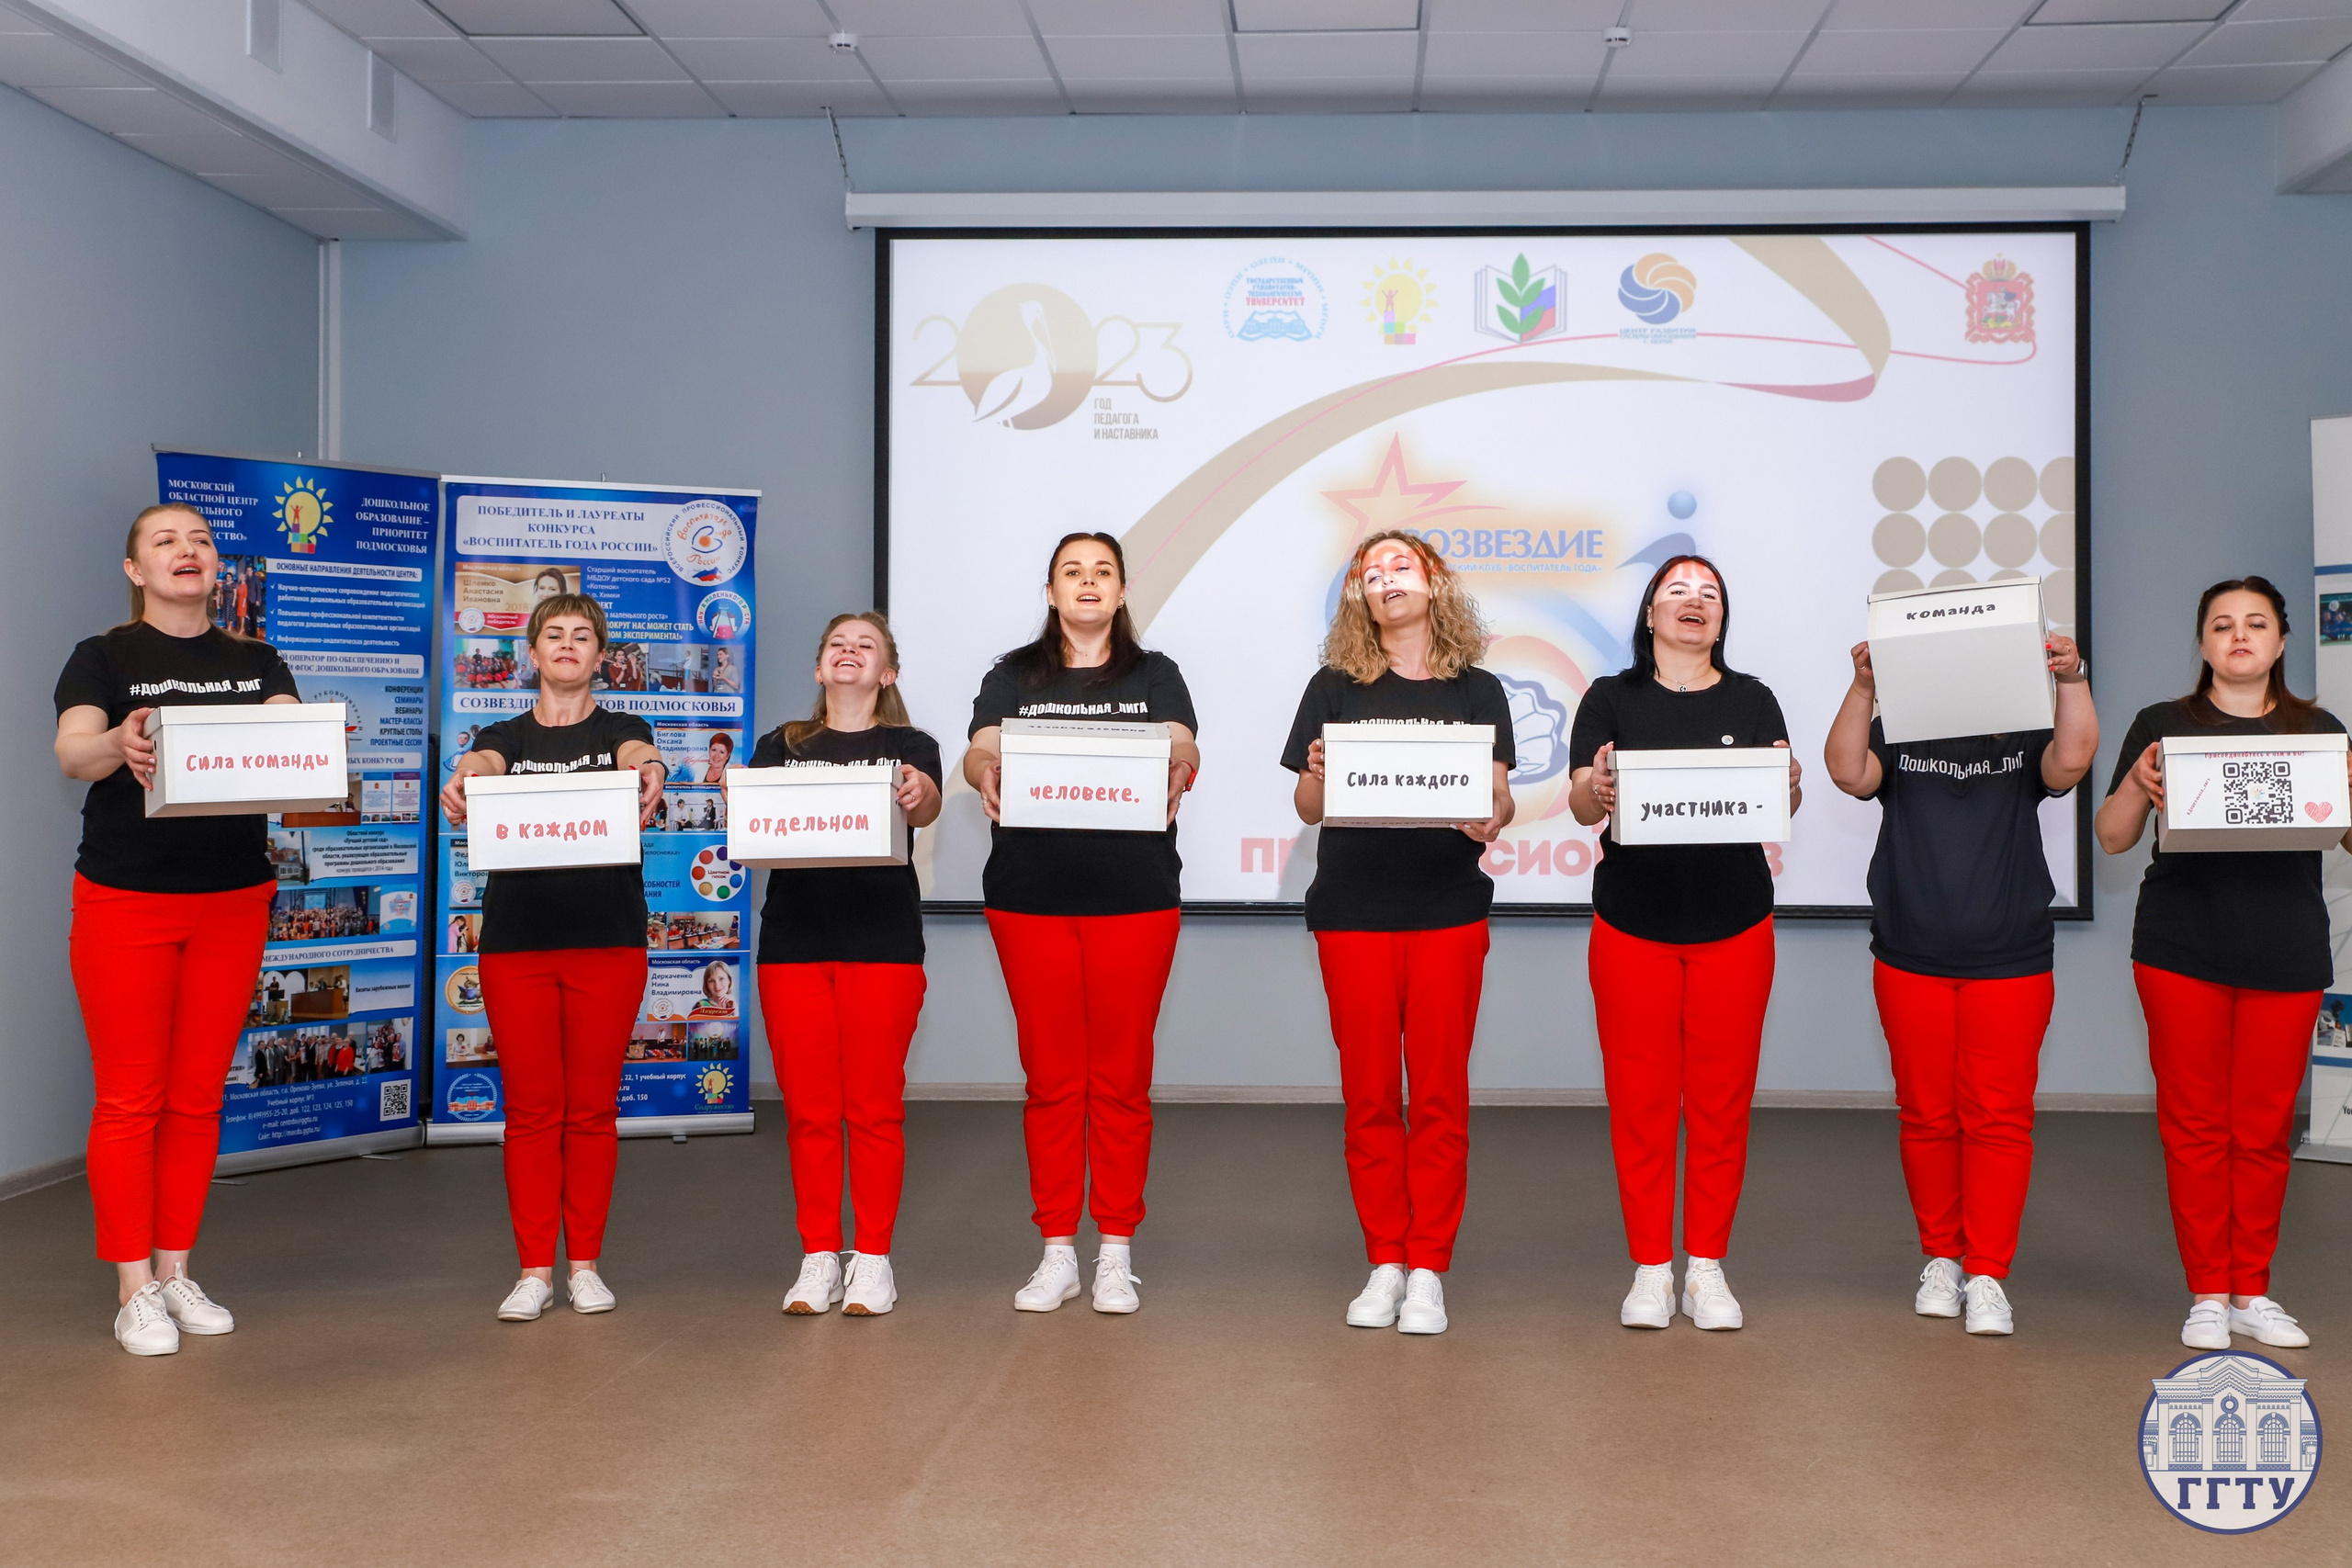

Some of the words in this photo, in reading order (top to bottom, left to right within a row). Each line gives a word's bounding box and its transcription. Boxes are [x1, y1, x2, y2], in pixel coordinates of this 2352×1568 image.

[1246, 297, 1305, 306] УНИВЕРСИТЕТ
[1094, 399, 1112, 410] ГОД
[1094, 413, 1139, 425] ПЕДАГОГА
[1094, 428, 1100, 439] И
[1102, 428, 1159, 439] НАСТАВНИКА
[168, 479, 235, 492] МОСКОВСКИЙ
[168, 491, 225, 504] ОБЛАСТНОЙ
[227, 497, 259, 507] ЦЕНТР
[361, 497, 430, 512] ДОШКОЛЬНОЕ
[197, 506, 243, 517] ОЛЬНОГО
[477, 505, 563, 519] ПОБЕДИТЕЛЬ
[566, 508, 575, 518] И
[577, 509, 645, 522] ЛАУРЕАТЫ
[356, 512, 422, 525] ОБРАЗОВАНИЕ
[681, 502, 745, 542] ПРОФЕССИОНАЛЬНЫЙ
[371, 527, 429, 540] ПРИОРИТЕТ
[527, 523, 595, 535] КОНКУРСА
[356, 540, 428, 554] ПОДМОСКОВЬЯ
[462, 536, 562, 550] «ВОСПИТАТЕЛЬ
[565, 539, 597, 551] ГОДА
[601, 541, 659, 553] РОССИИ»
[664, 513, 684, 572] ВСЕРОССИЙСКИЙ
[1403, 528, 1604, 558] ОЗВЕЗДИЕ
[727, 546, 745, 574] КОНКУРС
[276, 562, 309, 572] ОСНОВНЫЕ
[310, 564, 352, 575] НАПРАВЛЕНИЯ
[353, 567, 395, 578] ДЕЯТЕЛЬНОСТИ
[396, 570, 418, 580] ЦЕНТРА:
[586, 566, 616, 575] Старший
[1478, 564, 1502, 572] КЛУБ
[1504, 564, 1572, 572] «ВОСПИТАТЕЛЬ
[1574, 564, 1602, 573] ГОДА»
[463, 579, 496, 587] Шлемко
[586, 574, 611, 582] МБДОУ
[277, 583, 338, 594] Научно-методическое
[463, 595, 502, 604] Ивановна
[505, 603, 529, 612] 2018
[1906, 603, 1996, 621] команда
[631, 622, 646, 630] НАС
[646, 623, 673, 631] МОЖЕТ
[673, 623, 695, 631] СТАТЬ
[289, 654, 325, 662] ОПЕРАТОР
[338, 656, 391, 664] ОБЕСПЕЧЕНИЮ
[315, 665, 370, 674] ДОШКОЛЬНОГО
[370, 666, 420, 675] ОБРАЗОВАНИЯ
[130, 678, 263, 696] #ДОШКОЛЬНАЯ_ЛИГ
[384, 685, 424, 694] КОНФЕРЕНЦИИ
[459, 696, 535, 710] СОЗВЕЗДИ
[628, 700, 736, 713] ПОДМОСКОВЬЯ
[1018, 701, 1148, 717] #ДОШКОЛЬНАЯ_ЛИГА
[394, 706, 424, 715] ВЕБИНАРЫ
[656, 745, 708, 753] Владимировна
[186, 754, 234, 773] Сила
[242, 753, 329, 771] команды
[362, 757, 404, 765] КОНКУРСОВ
[1347, 772, 1388, 788] Сила
[1395, 773, 1470, 790] каждого
[1030, 784, 1140, 804] человеке.
[1641, 799, 1748, 822] участника
[495, 823, 509, 840] в
[518, 818, 608, 841] каждом
[749, 814, 869, 837] отдельном
[644, 880, 681, 888] СОБНОСТЕЙ
[263, 951, 332, 963] МЕЖДУНАРОДНОГО
[332, 946, 394, 958] СОТРУДНИЧЕСТВА
[639, 1073, 666, 1082] учебный
[666, 1073, 686, 1081] корпус
[230, 1090, 259, 1101] Московская
[621, 1094, 635, 1102] доб.
[637, 1093, 648, 1101] 150
[345, 1100, 354, 1108] 150
